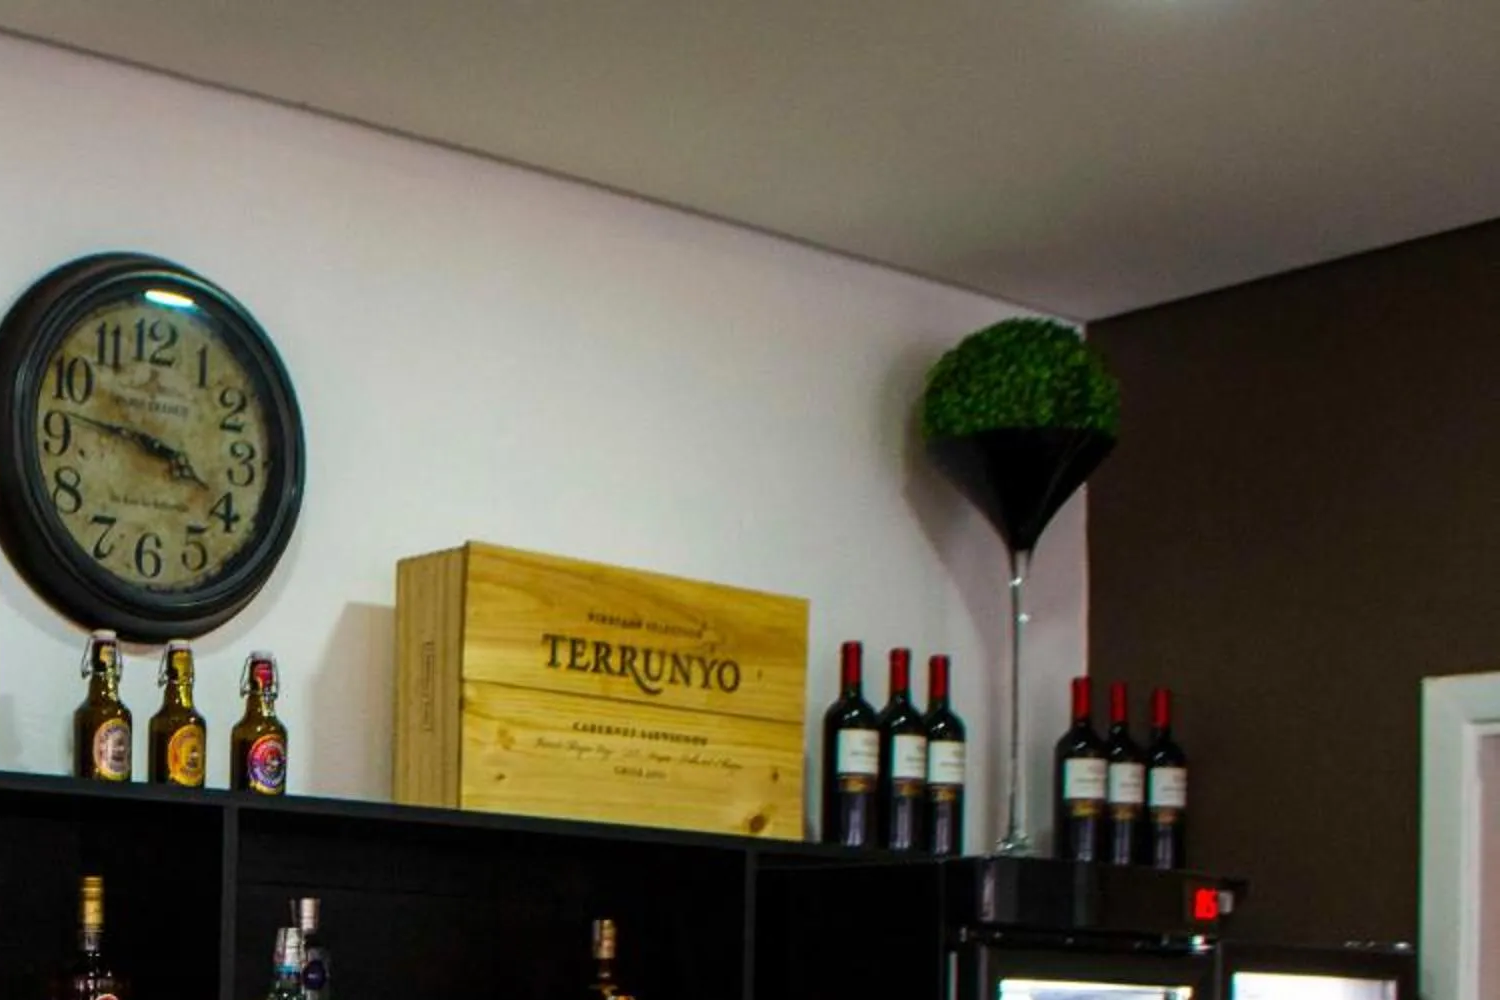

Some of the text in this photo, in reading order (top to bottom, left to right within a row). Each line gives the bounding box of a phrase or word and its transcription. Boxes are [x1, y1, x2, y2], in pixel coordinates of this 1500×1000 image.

[96, 322, 121, 373] 11
[132, 317, 179, 368] 12
[52, 355, 94, 405] 10
[196, 344, 209, 390] 1
[219, 386, 247, 432] 2
[43, 410, 72, 457] 9
[227, 441, 255, 487] 3
[52, 466, 82, 514] 8
[208, 492, 240, 533] 4
[90, 515, 117, 560] 7
[134, 533, 162, 579] 6
[181, 525, 208, 572] 5
[542, 633, 741, 695] TERRUNYO
